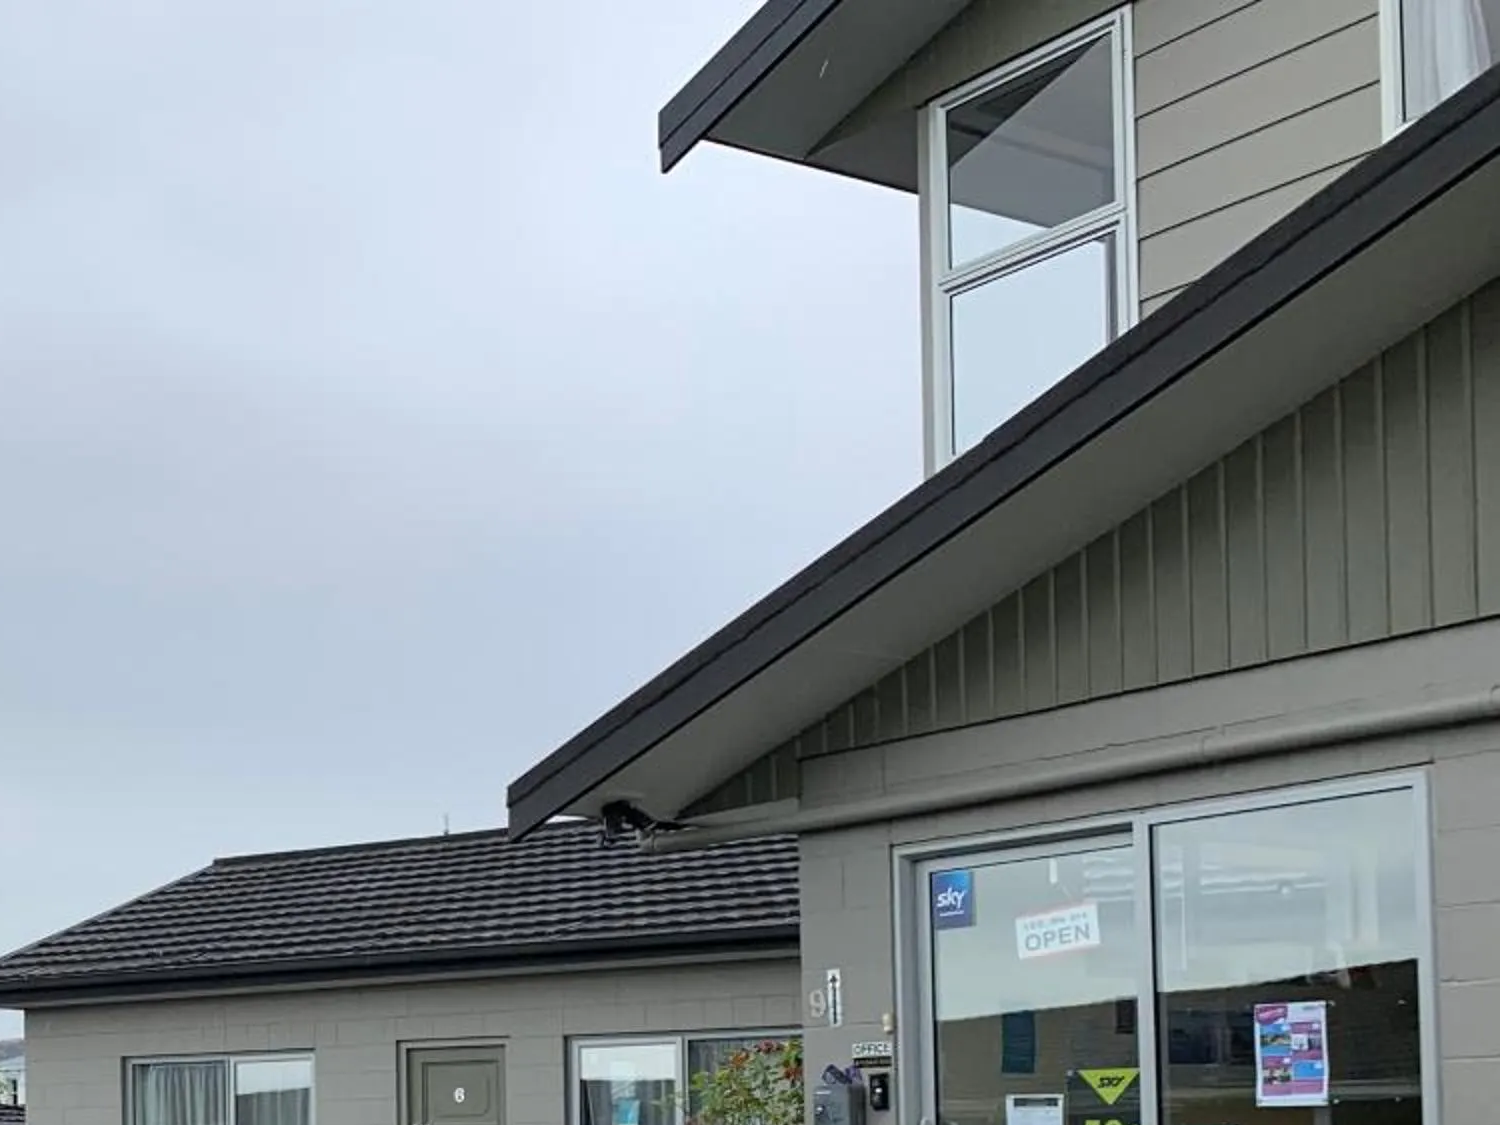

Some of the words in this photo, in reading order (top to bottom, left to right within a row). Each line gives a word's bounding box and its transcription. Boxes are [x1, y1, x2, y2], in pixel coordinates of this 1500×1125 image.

[1024, 922, 1091, 952] OPEN
[809, 989, 826, 1018] 9
[853, 1043, 891, 1055] OFFICE
[455, 1087, 465, 1103] 6
